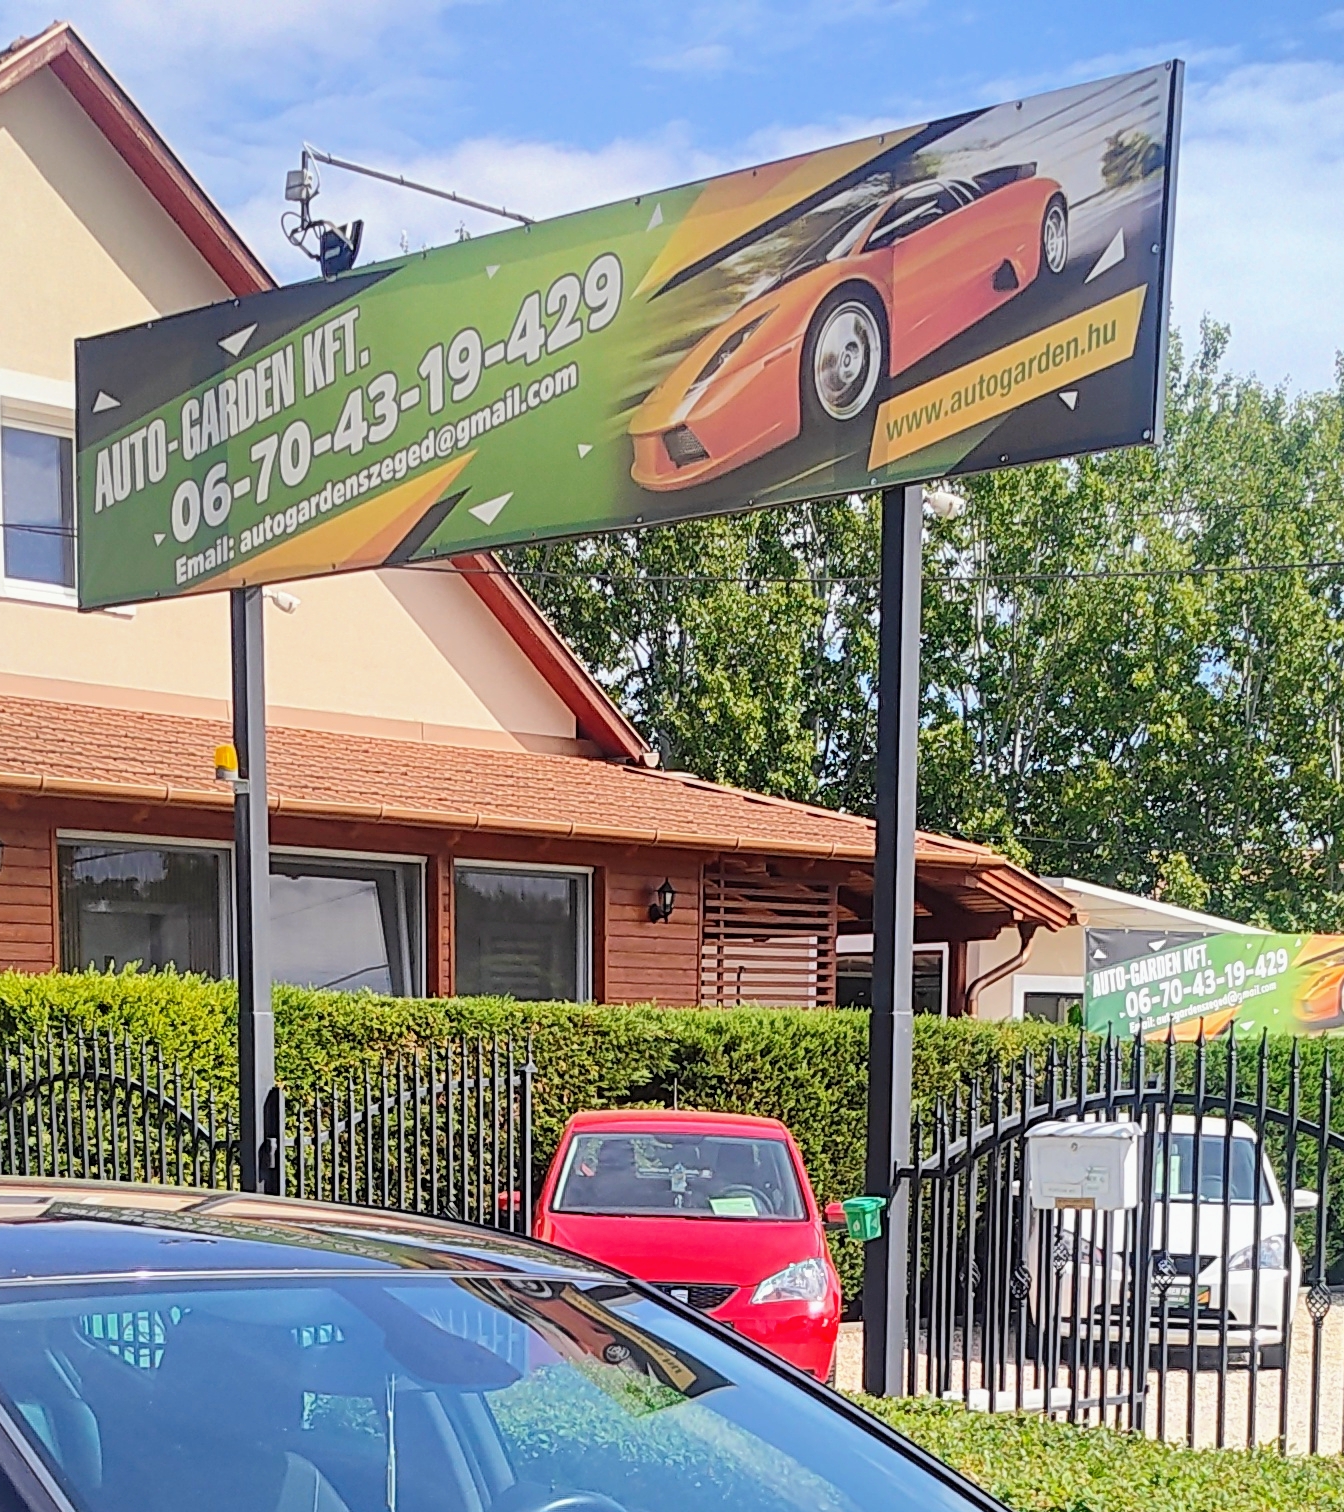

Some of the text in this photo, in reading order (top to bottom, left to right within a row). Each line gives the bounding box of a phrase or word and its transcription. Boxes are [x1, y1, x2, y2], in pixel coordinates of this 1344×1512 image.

[94, 307, 370, 514] AUTO-GARDEN KFT.
[170, 252, 624, 543] 06-70-43-19-429
[886, 319, 1117, 442] www.autogarden.hu
[175, 361, 578, 585] Email: autogardenszeged@gmail.com
[1092, 943, 1212, 998] AUTO-GARDEN KFT.
[1125, 948, 1288, 1018] 06-70-43-19-429
